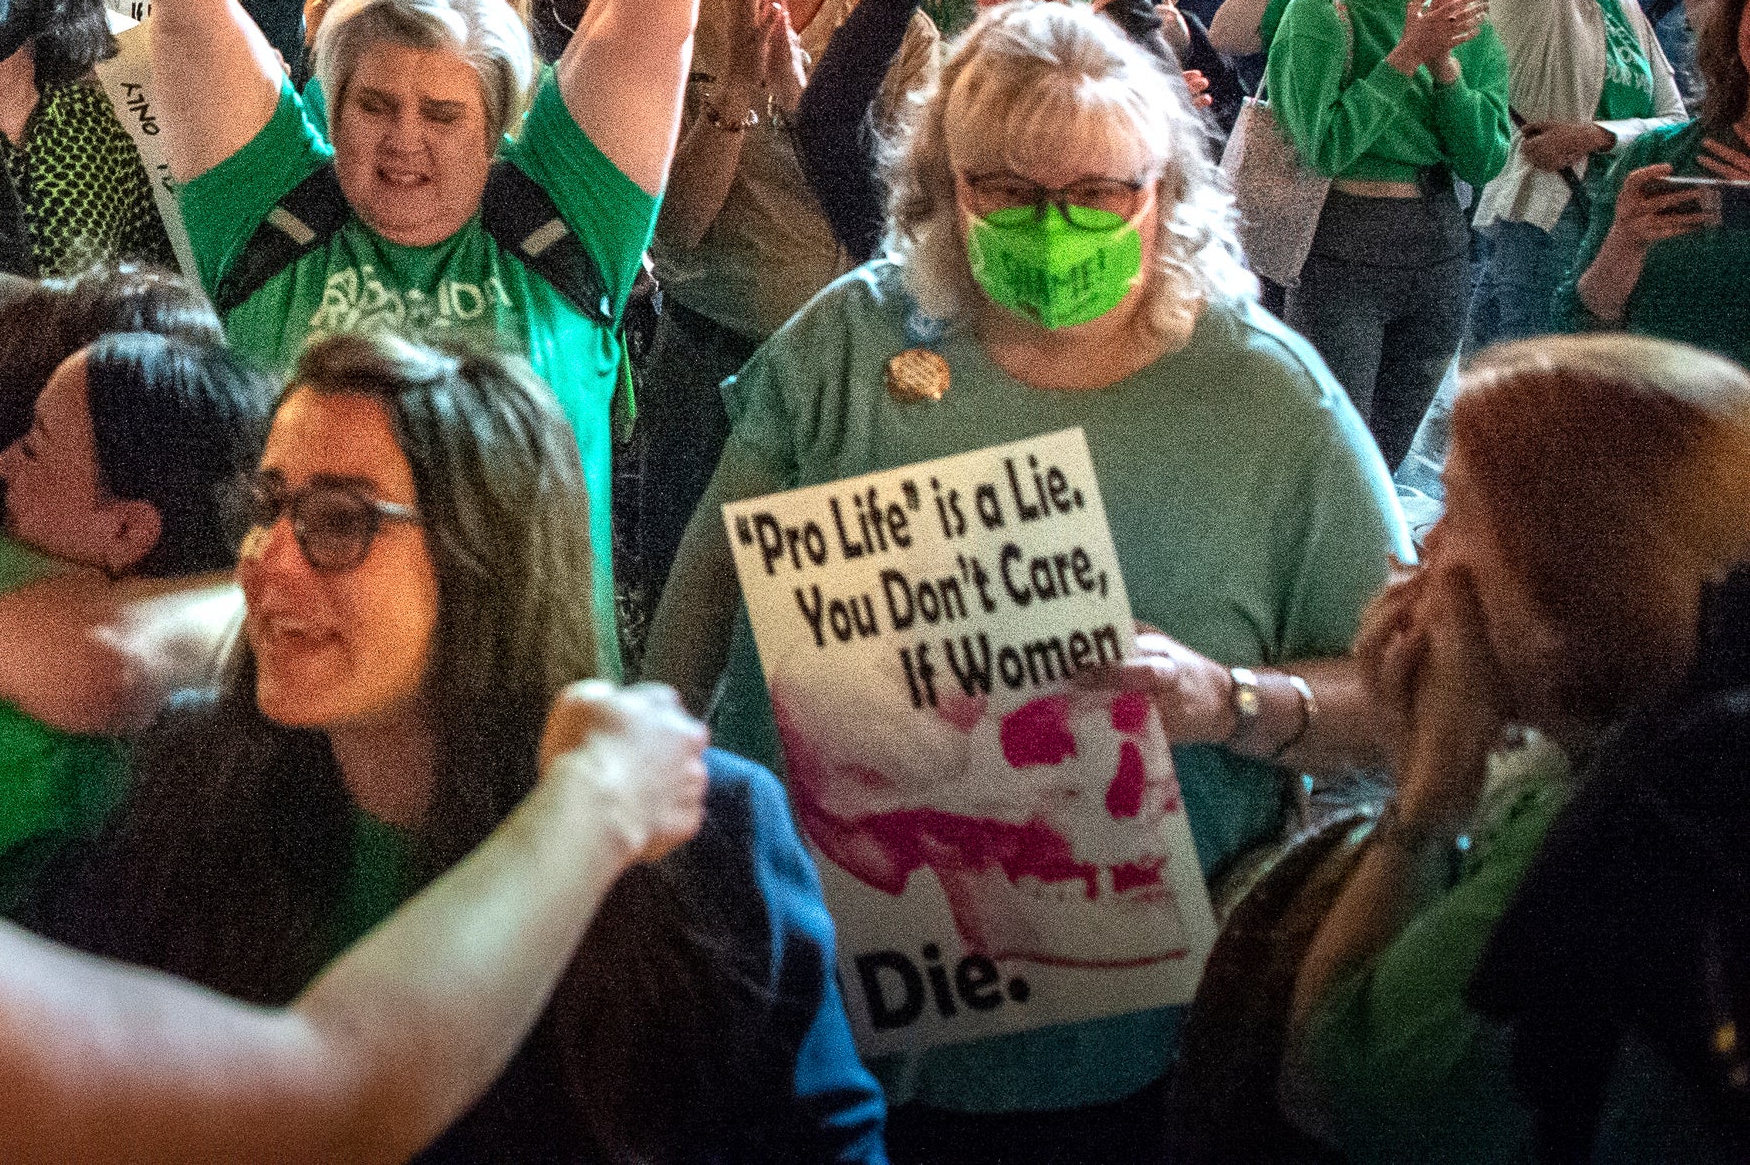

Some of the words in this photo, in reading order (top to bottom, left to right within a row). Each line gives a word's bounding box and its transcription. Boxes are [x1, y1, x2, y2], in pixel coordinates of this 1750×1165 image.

[929, 476, 967, 540] is
[975, 489, 1003, 528] a
[1002, 454, 1085, 522] Lie.
[794, 586, 879, 648] You
[881, 554, 995, 628] Don't
[999, 543, 1110, 601] Care,
[898, 647, 939, 710] If
[941, 623, 1124, 698] Women
[856, 944, 1032, 1032] Die.
